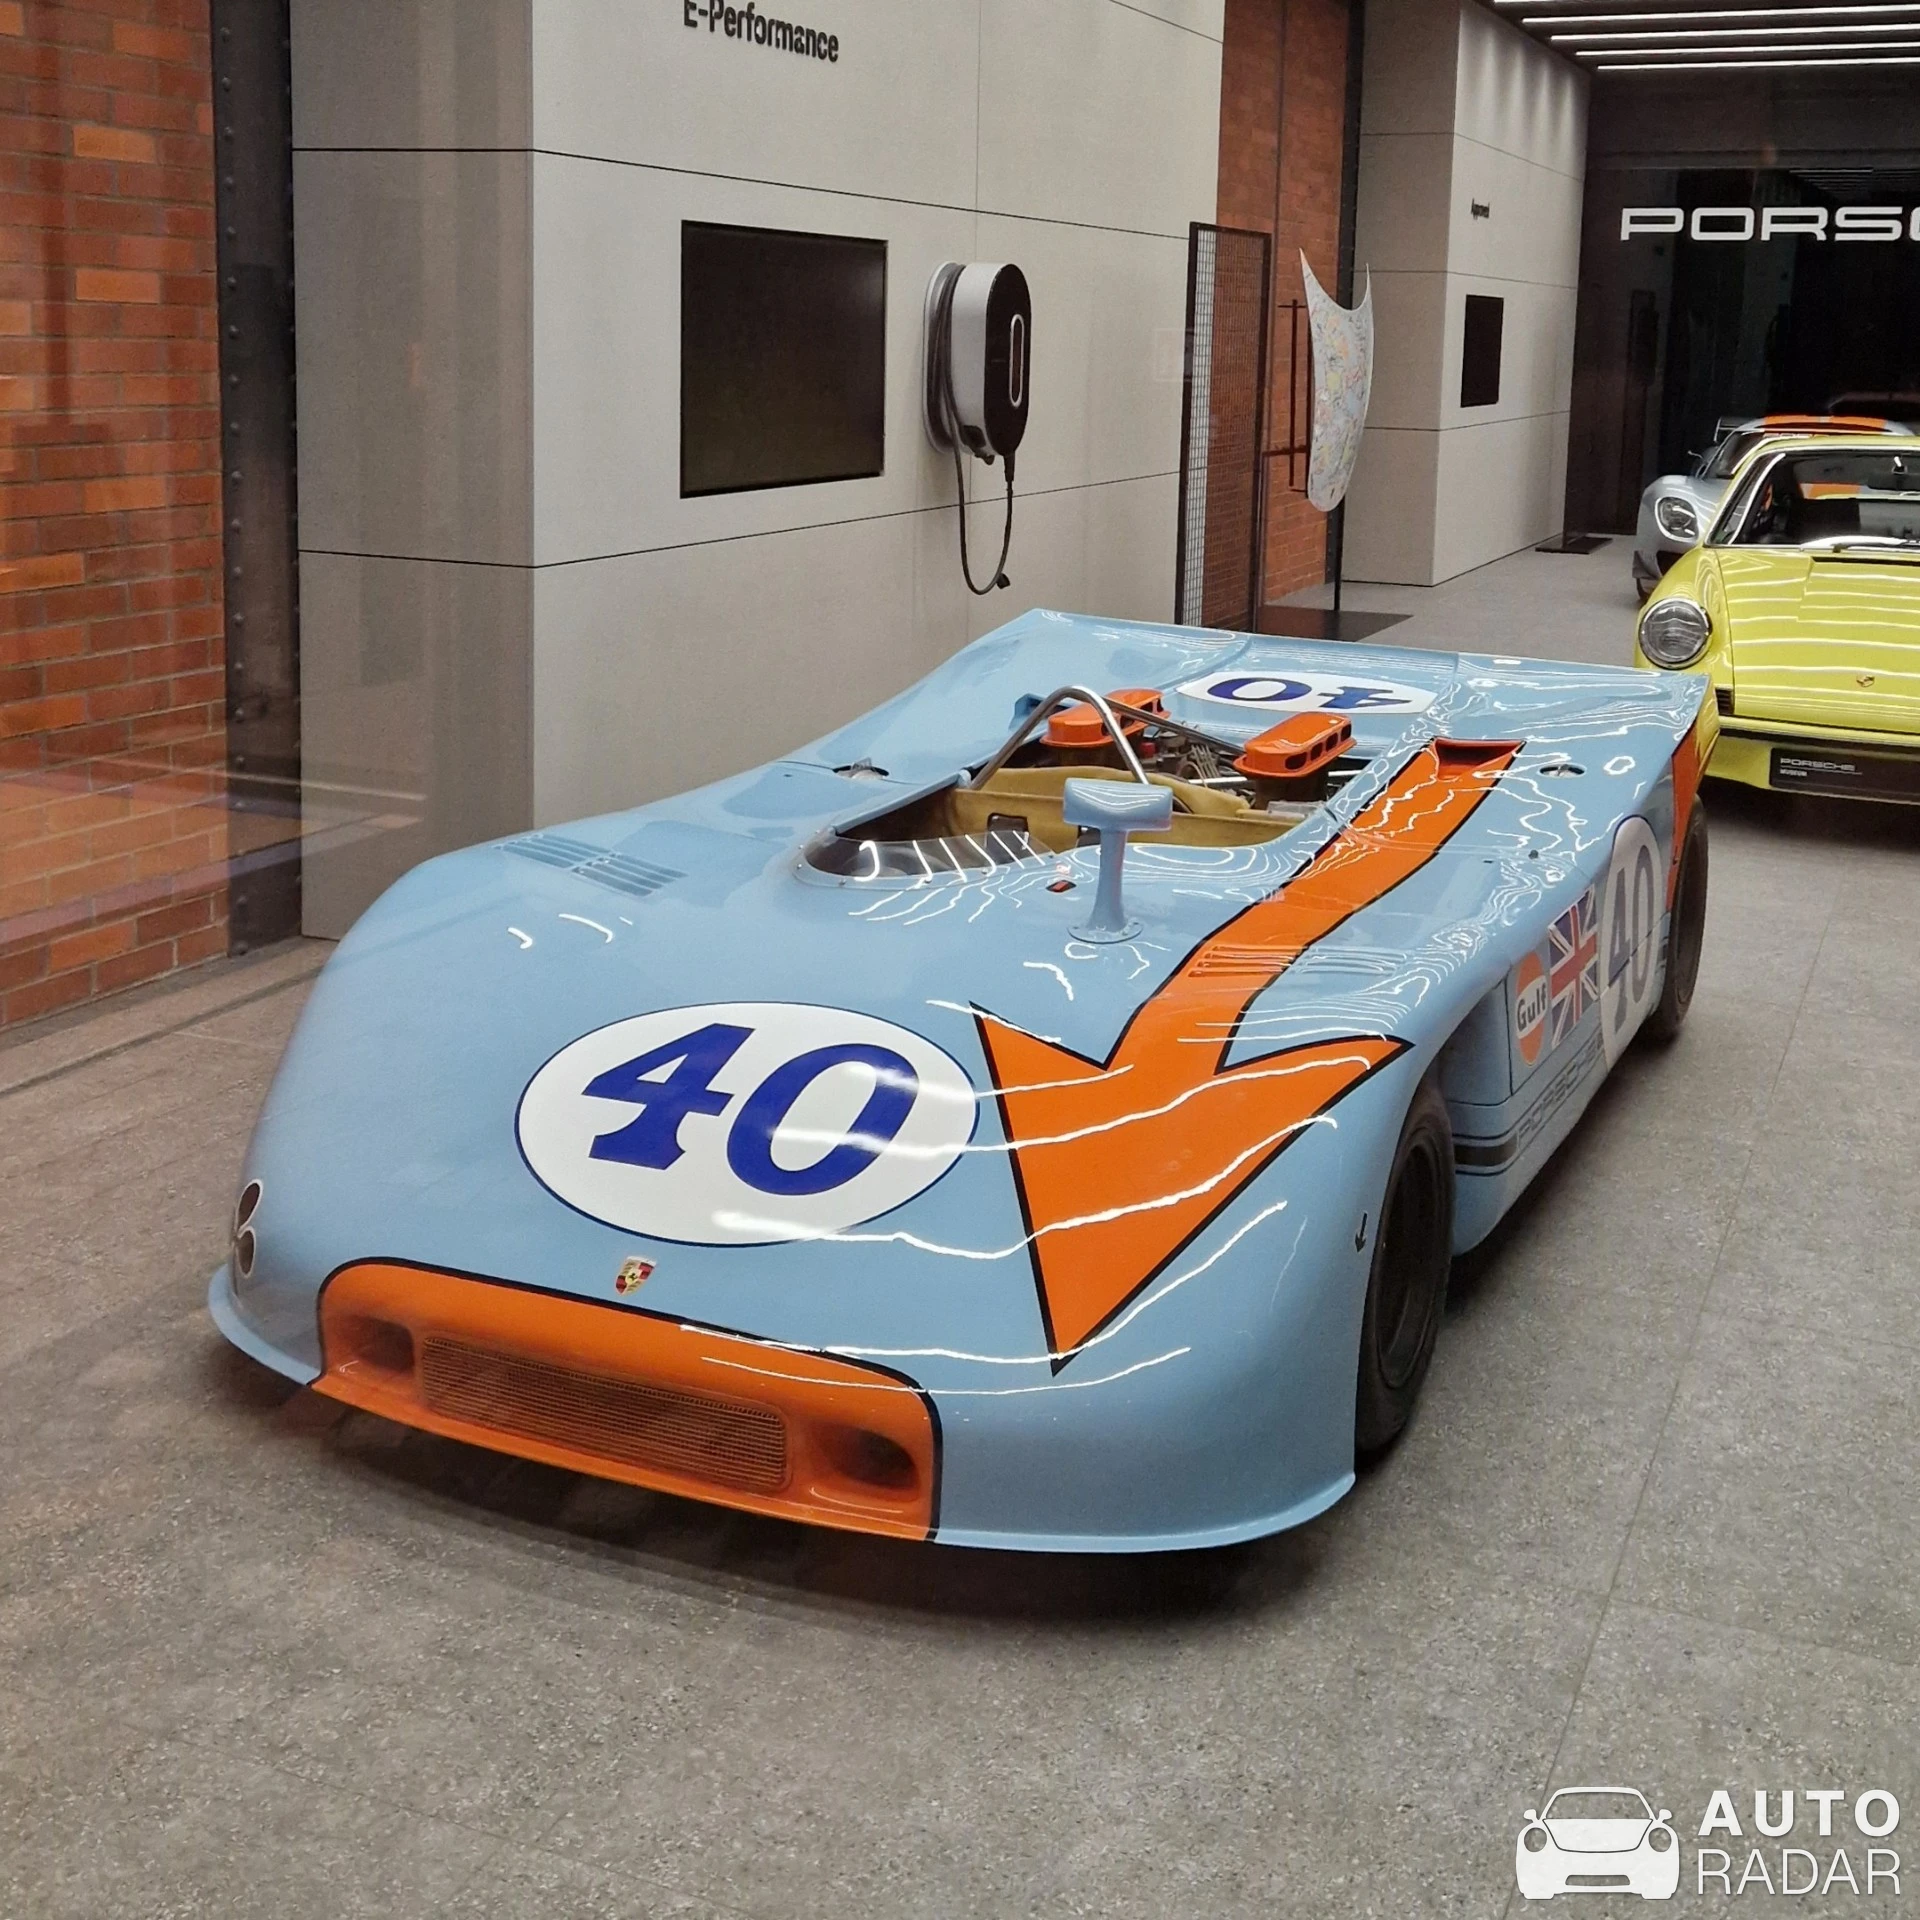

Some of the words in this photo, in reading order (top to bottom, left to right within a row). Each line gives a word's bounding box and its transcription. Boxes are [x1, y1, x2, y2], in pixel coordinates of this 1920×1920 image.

[684, 0, 840, 62] E-Performance
[1620, 206, 1920, 242] PORS
[1780, 758, 1856, 772] PORSCHE
[1608, 844, 1651, 1035] 40
[1516, 983, 1548, 1032] Gulf
[580, 1022, 920, 1196] 40
